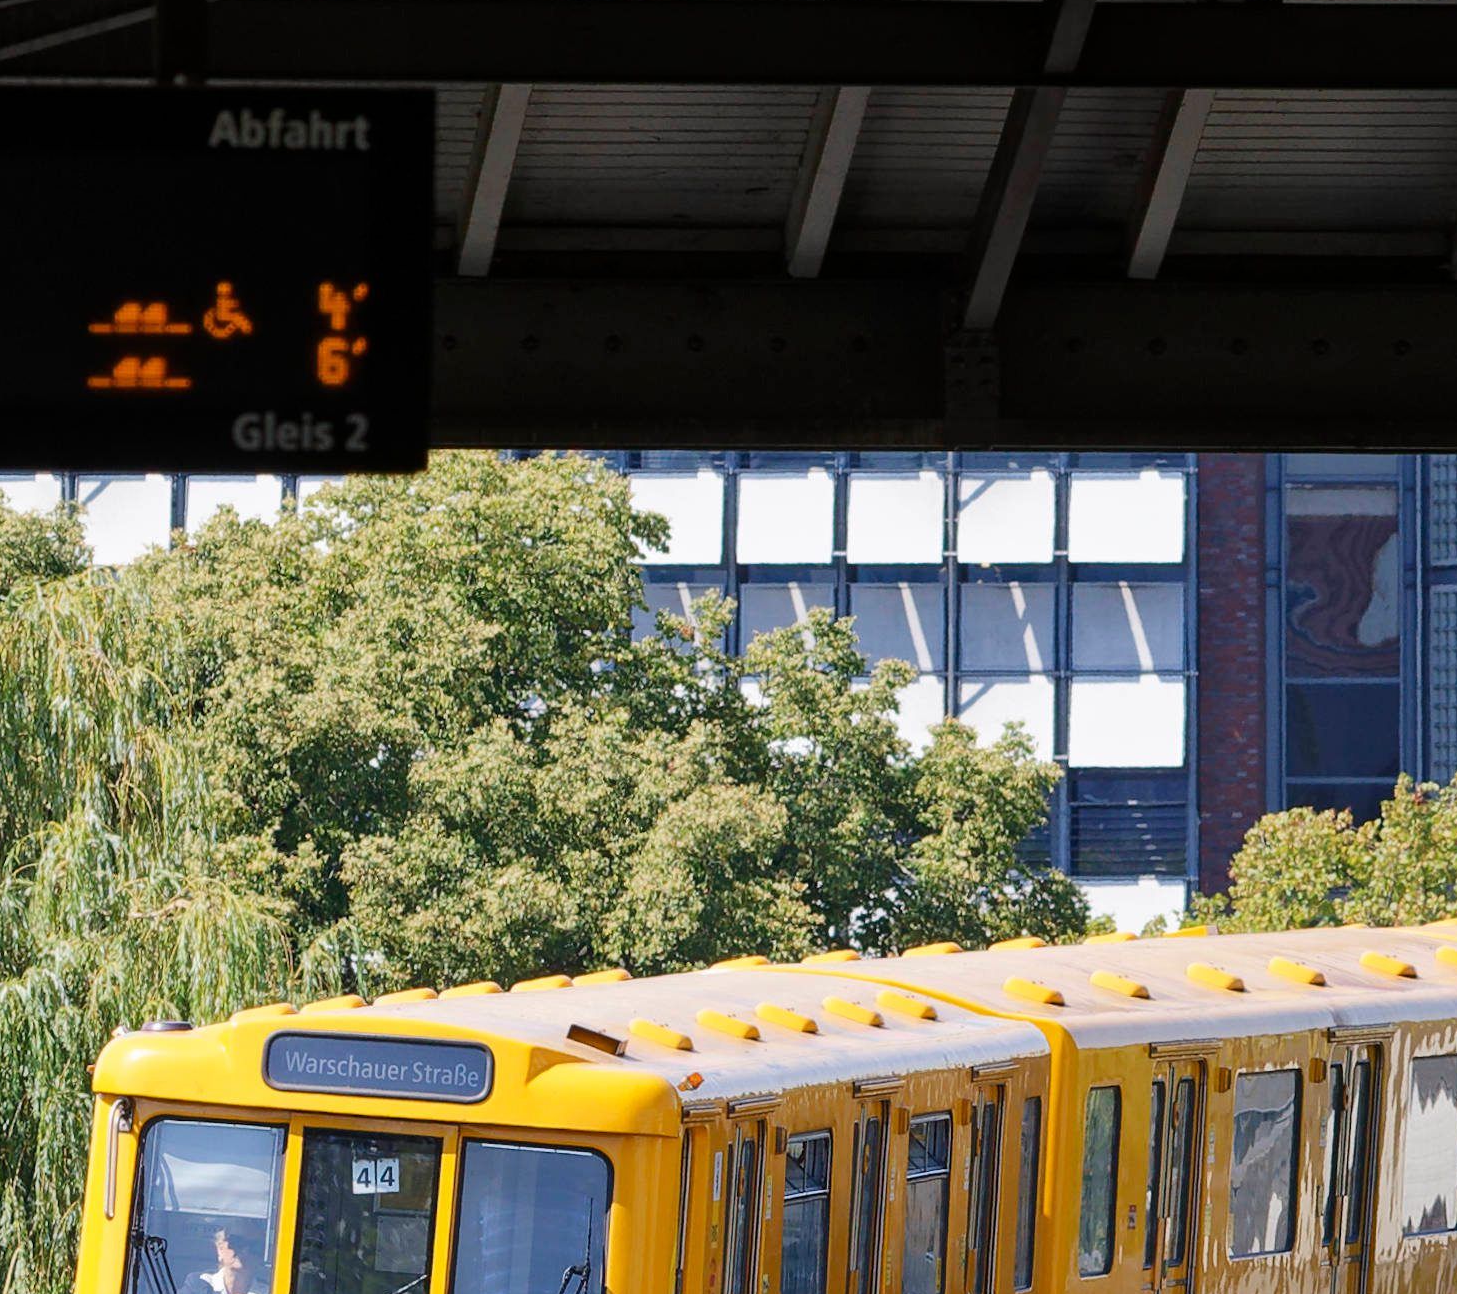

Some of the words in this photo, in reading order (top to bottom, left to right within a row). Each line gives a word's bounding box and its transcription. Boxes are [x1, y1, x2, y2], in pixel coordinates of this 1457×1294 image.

[208, 109, 371, 151] Abfahrt
[233, 413, 333, 451] Gleis
[346, 414, 368, 451] 2
[286, 1052, 408, 1081] Warschauer
[412, 1061, 479, 1087] Straße
